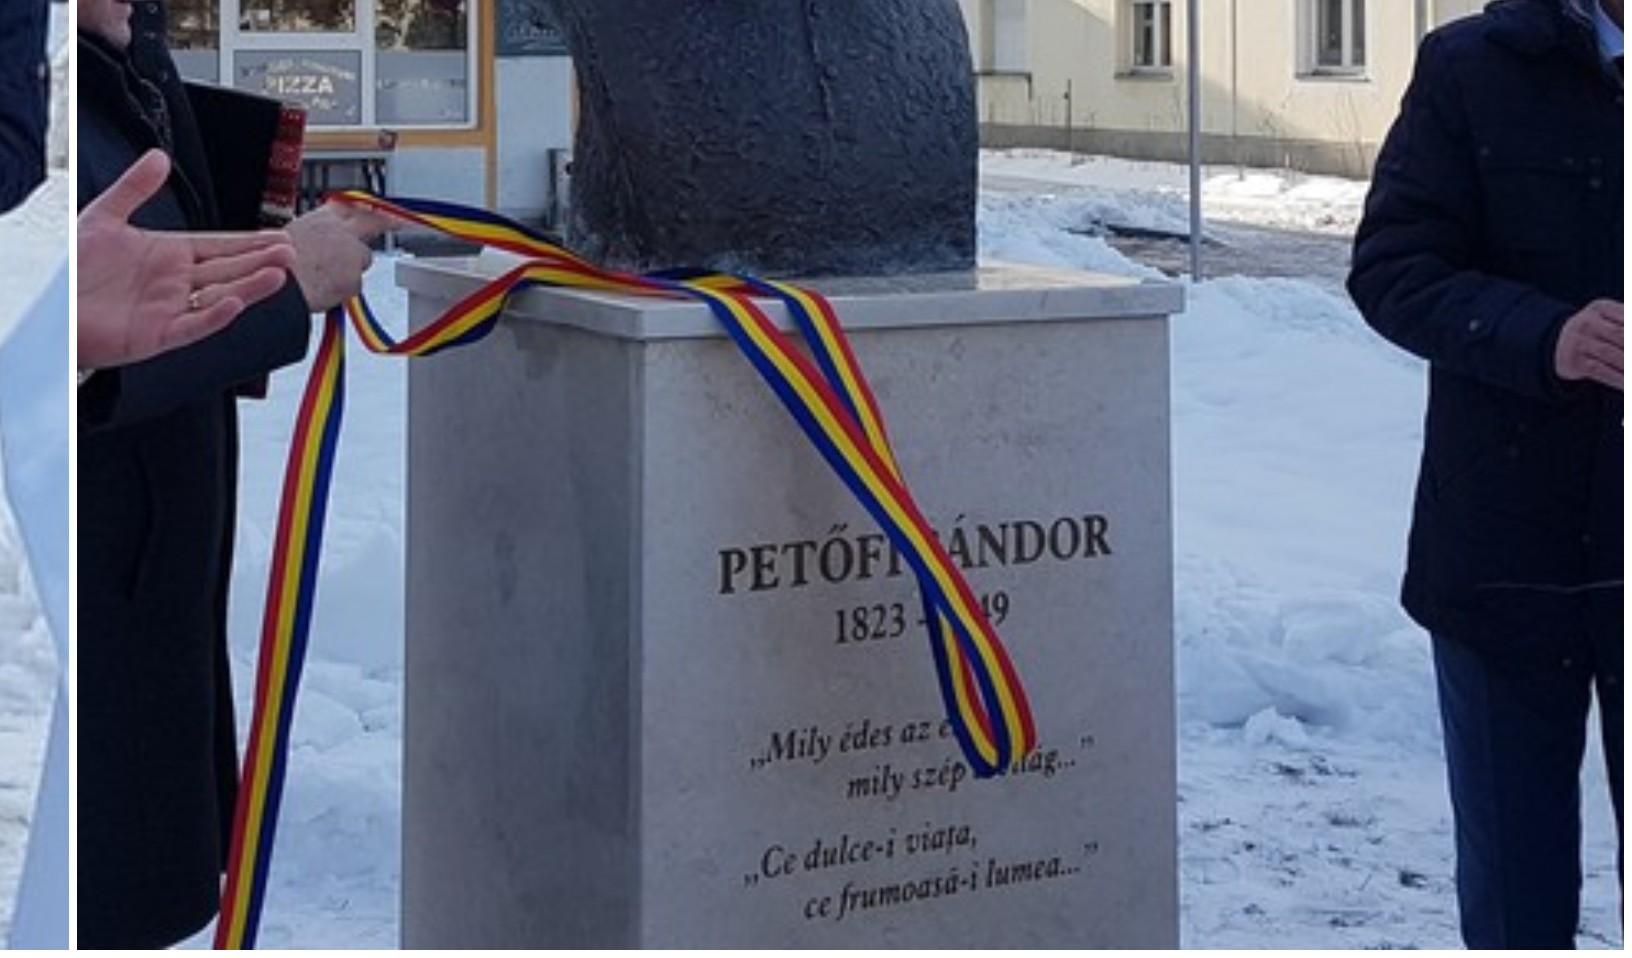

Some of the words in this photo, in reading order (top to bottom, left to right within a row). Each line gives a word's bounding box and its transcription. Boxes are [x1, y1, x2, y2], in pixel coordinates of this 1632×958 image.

[932, 514, 1112, 570] ÁNDOR
[834, 603, 905, 644] 1823
[839, 720, 893, 753] édes
[900, 721, 931, 744] az
[846, 764, 905, 801] mily
[911, 758, 967, 793] szép
[803, 828, 898, 874] dulce-i
[803, 895, 831, 920] ce
